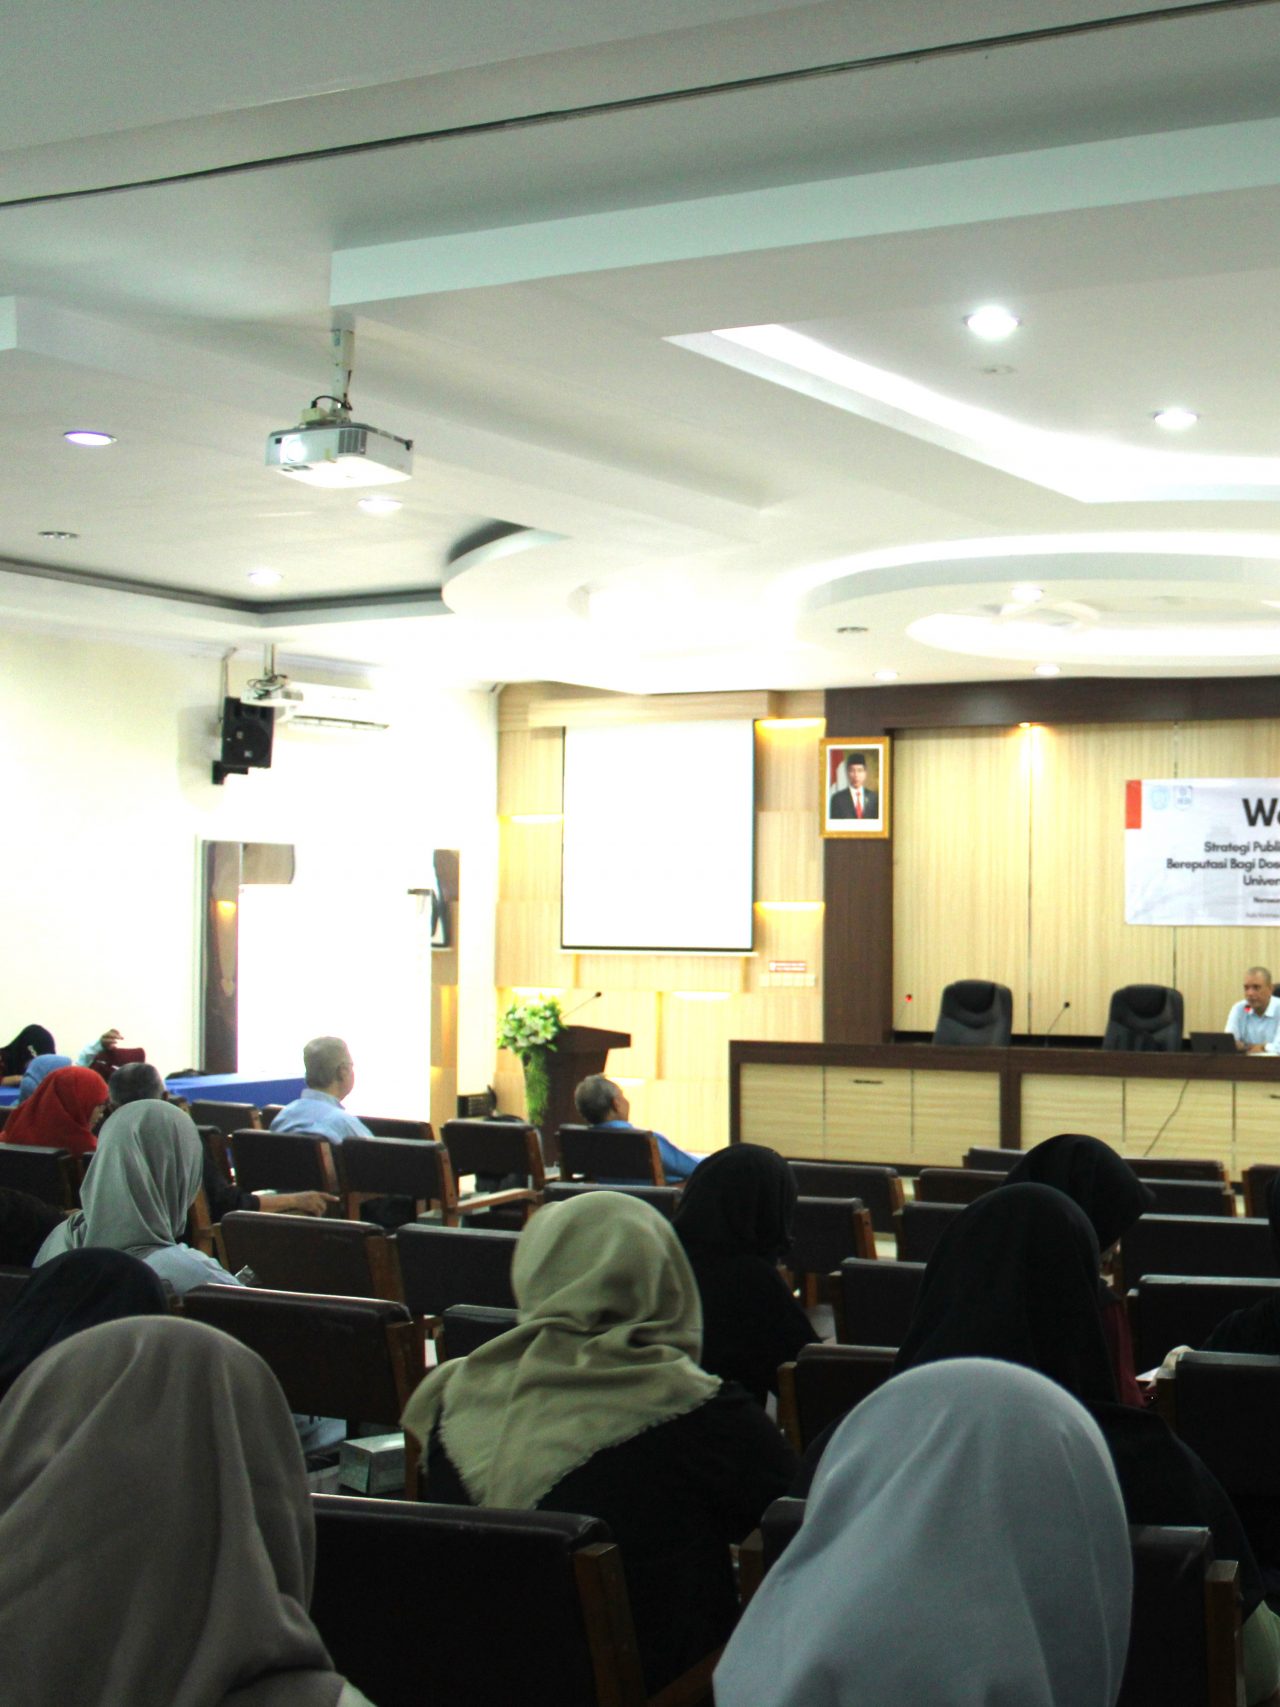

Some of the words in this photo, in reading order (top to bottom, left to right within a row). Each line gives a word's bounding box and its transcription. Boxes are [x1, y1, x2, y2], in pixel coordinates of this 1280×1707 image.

[1204, 841, 1250, 856] Strategi
[1166, 858, 1228, 872] Bereputasi
[1230, 858, 1256, 872] Bagi
